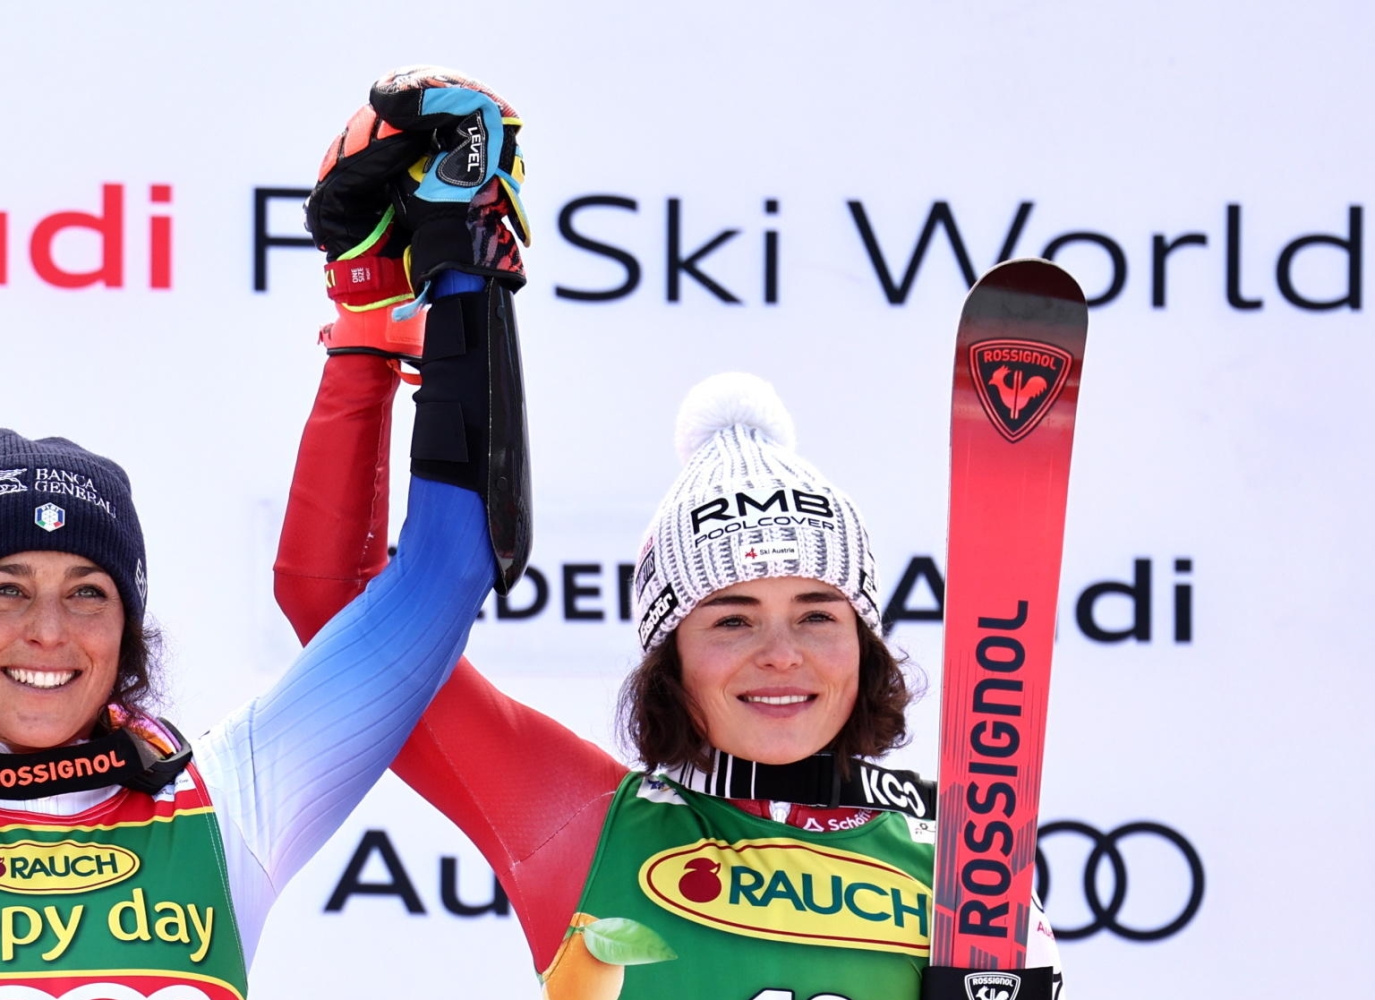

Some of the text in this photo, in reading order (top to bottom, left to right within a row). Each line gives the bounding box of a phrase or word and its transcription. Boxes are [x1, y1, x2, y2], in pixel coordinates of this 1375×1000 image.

[467, 126, 480, 172] LEVEL
[553, 193, 781, 306] Ski
[846, 200, 1363, 312] World
[983, 349, 1057, 371] ROSSIGNOL
[36, 468, 97, 493] BANCA
[690, 489, 834, 535] RMB
[694, 516, 835, 549] POOLCOVER
[771, 547, 795, 555] Austria
[880, 556, 1193, 644] Adi
[960, 600, 1029, 940] ROSSIGNOL
[10, 853, 119, 880] RAUCH
[322, 829, 511, 918] Au
[729, 864, 928, 938] RAUCH
[107, 888, 215, 963] day
[972, 975, 1014, 988] ROSSIGNOL
